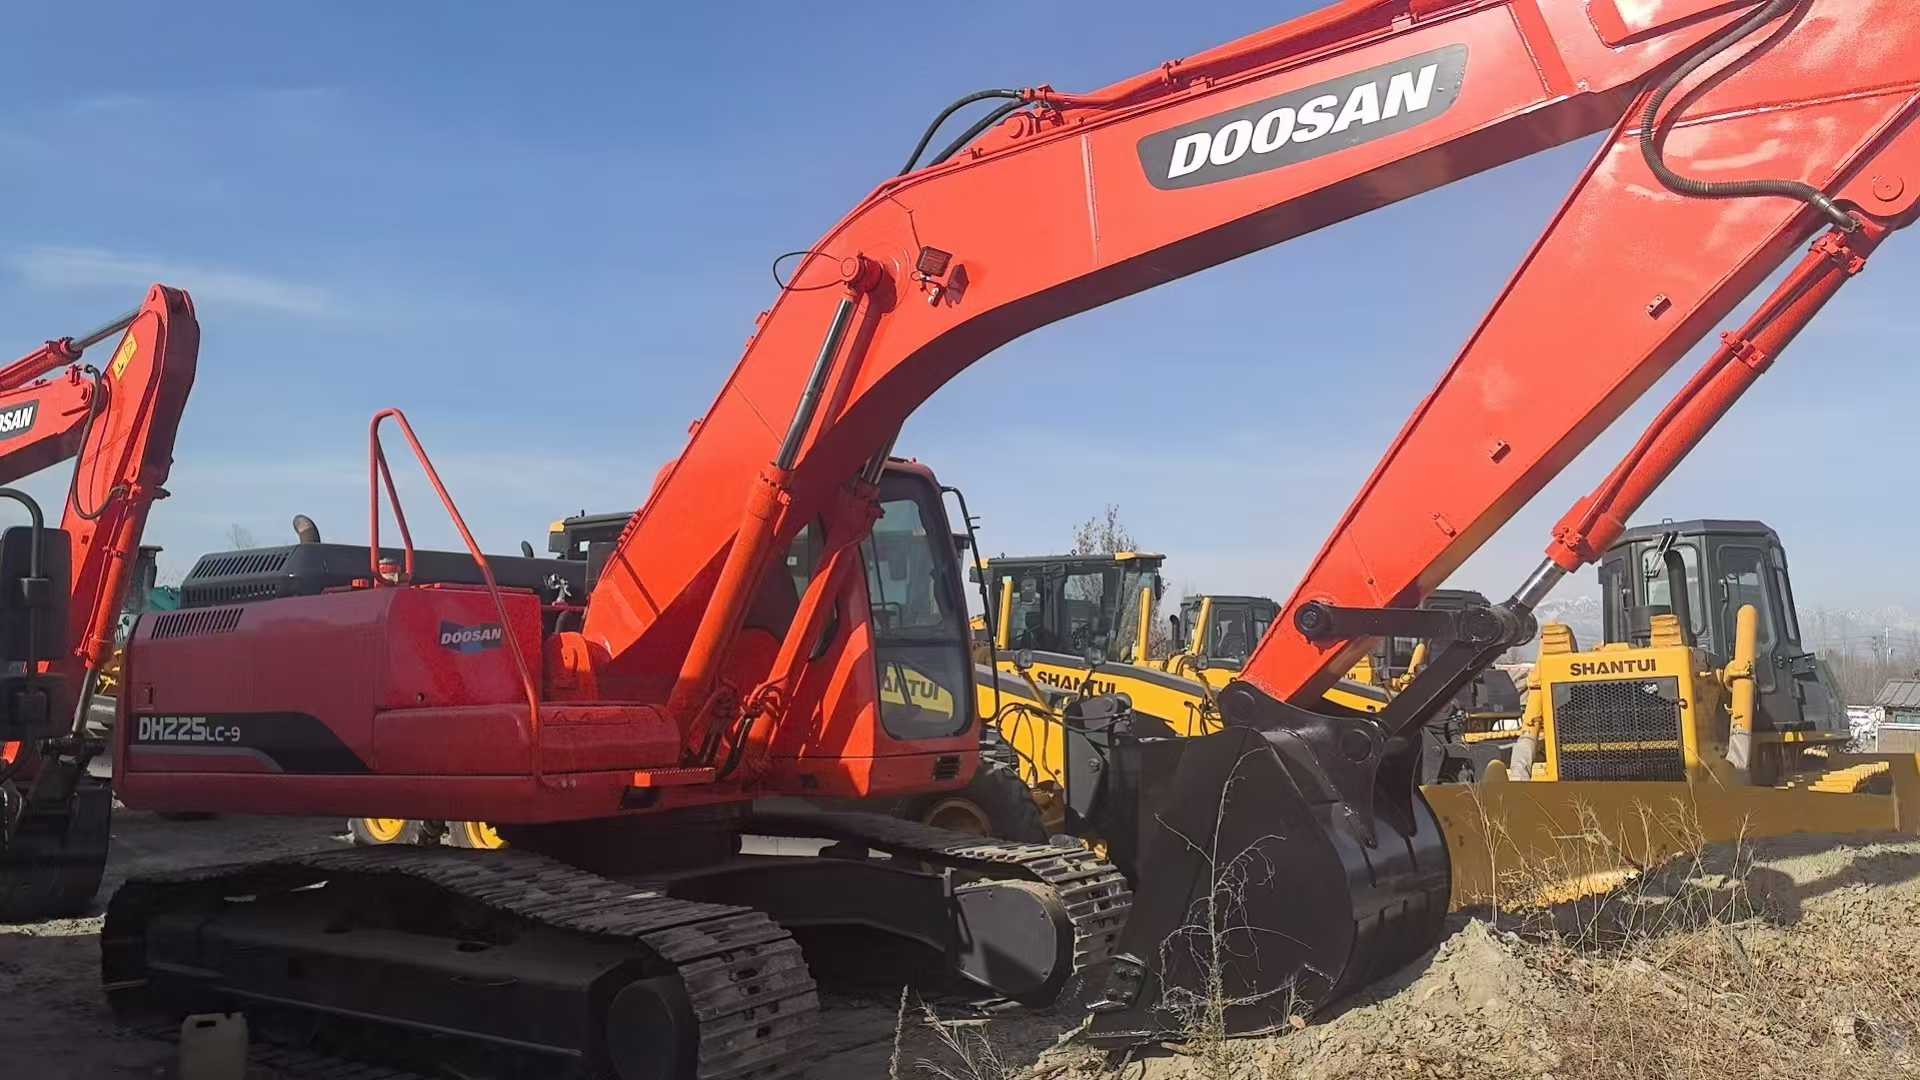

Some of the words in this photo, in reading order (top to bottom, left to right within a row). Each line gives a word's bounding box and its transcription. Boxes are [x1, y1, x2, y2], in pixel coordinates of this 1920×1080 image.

[1168, 64, 1438, 179] DOOSAN
[441, 628, 502, 645] DOOSAN
[1570, 658, 1656, 676] SHANTUI
